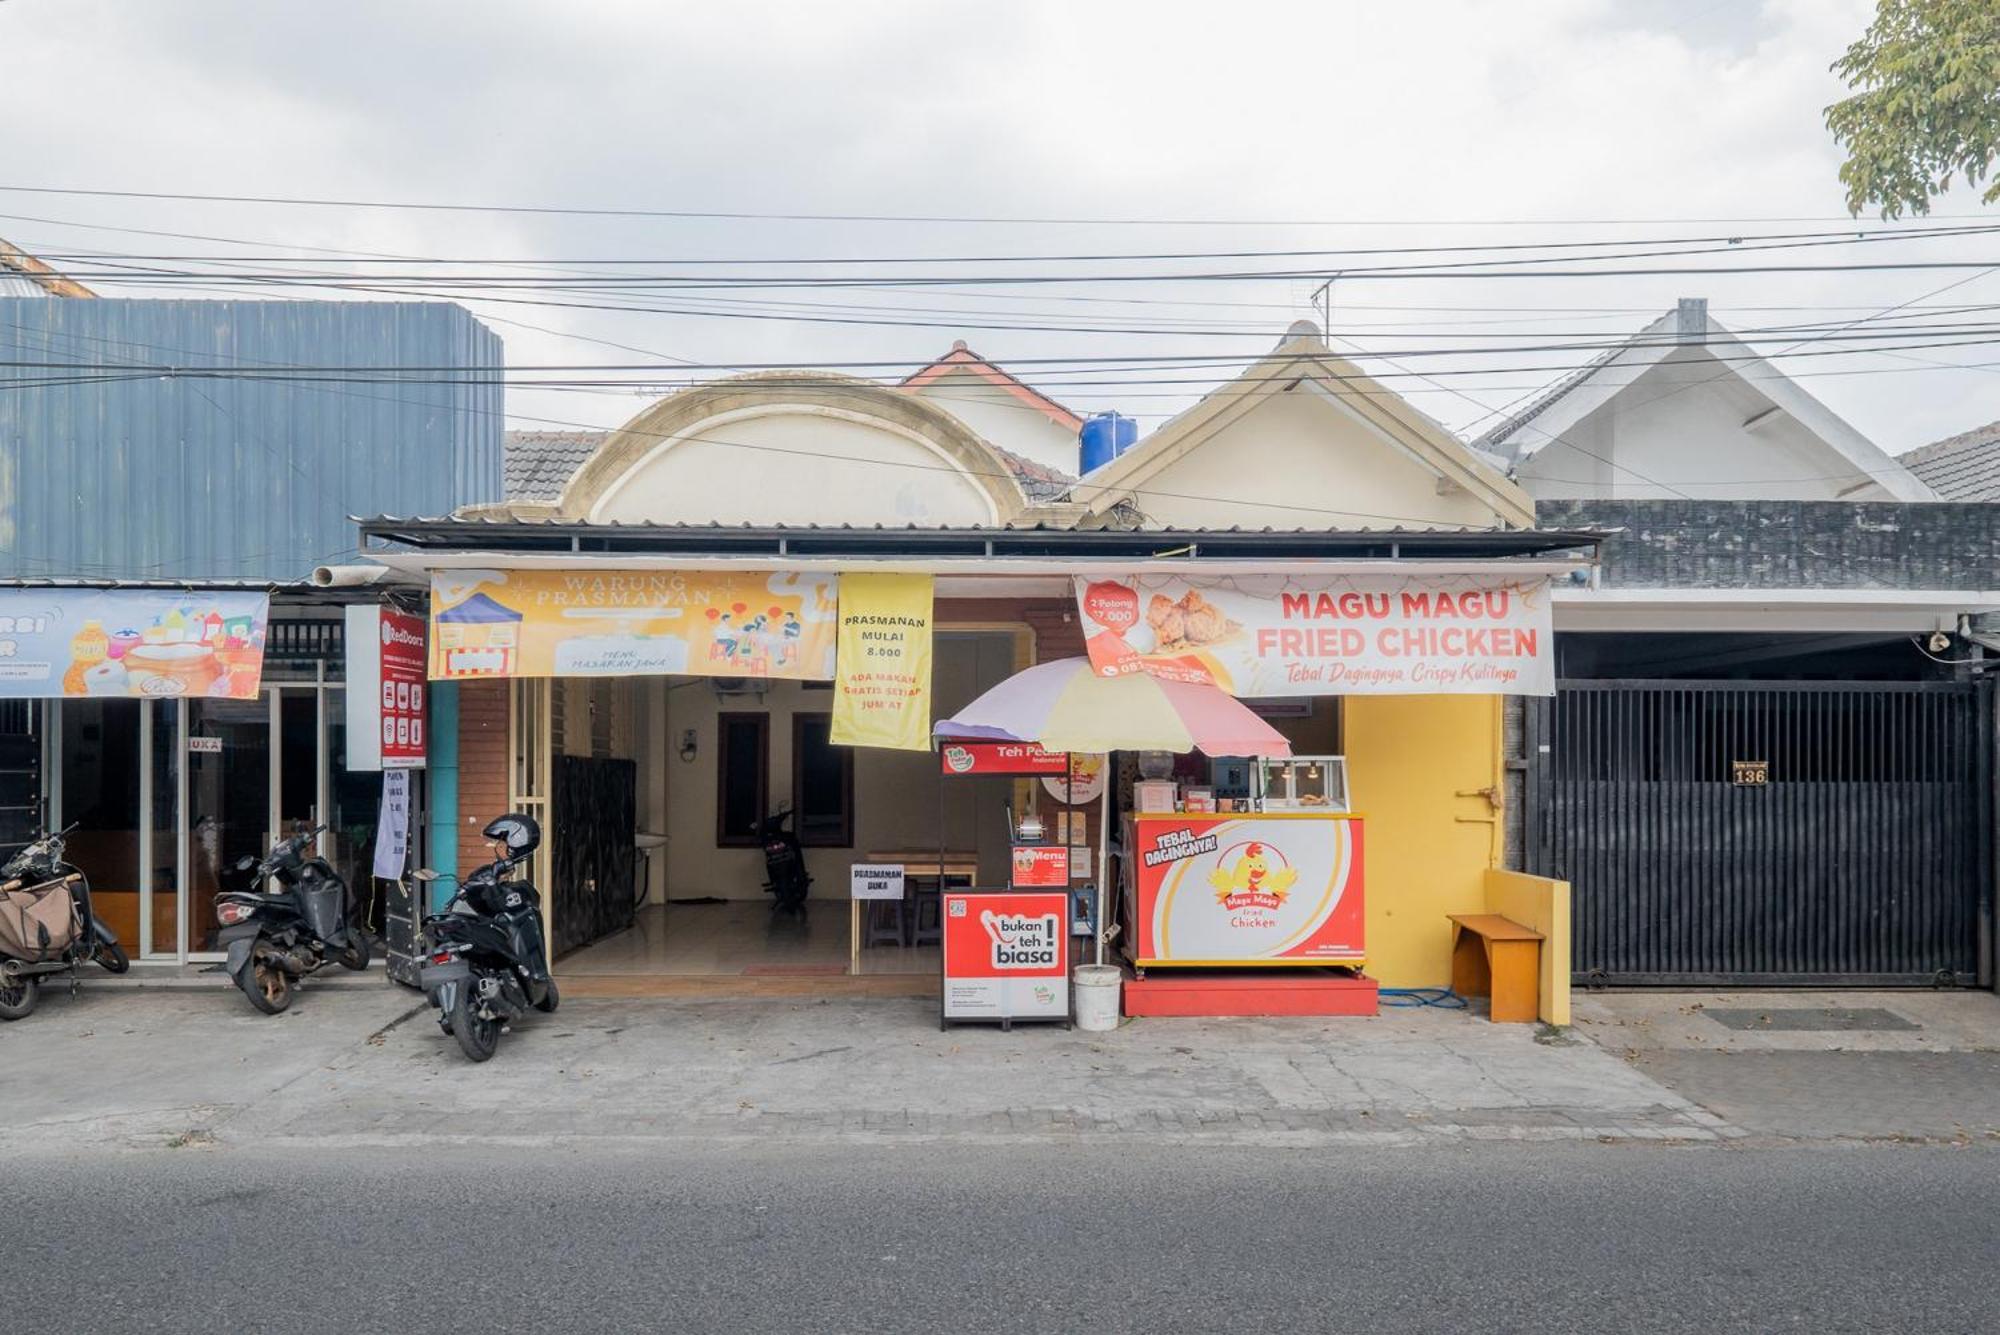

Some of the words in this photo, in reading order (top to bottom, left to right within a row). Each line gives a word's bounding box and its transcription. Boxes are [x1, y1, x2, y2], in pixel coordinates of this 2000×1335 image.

[564, 576, 686, 591] WARUNG
[536, 591, 711, 605] PRASMANAN
[1090, 600, 1098, 608] 2
[1281, 592, 1391, 620] MAGU
[1401, 590, 1509, 619] MAGU
[862, 632, 904, 641] MULAI
[1257, 628, 1366, 657] FRIED
[1376, 627, 1537, 657] CHICKEN
[867, 648, 901, 657] 8.000
[850, 673, 872, 681] ADA
[1284, 662, 1323, 684] Tebal
[1326, 662, 1404, 685] Dagingnya
[1411, 662, 1457, 685] Crispy
[1459, 664, 1518, 684] Kulitnya
[997, 747, 1023, 757] Teh
[1736, 770, 1765, 784] 136
[1156, 829, 1196, 848] TEBAL
[1144, 836, 1217, 866] DAGINGNYA!
[1001, 919, 1042, 932] bukan
[1231, 917, 1275, 928] Chicken
[1019, 933, 1041, 947] teh
[996, 944, 1053, 963] biasa
